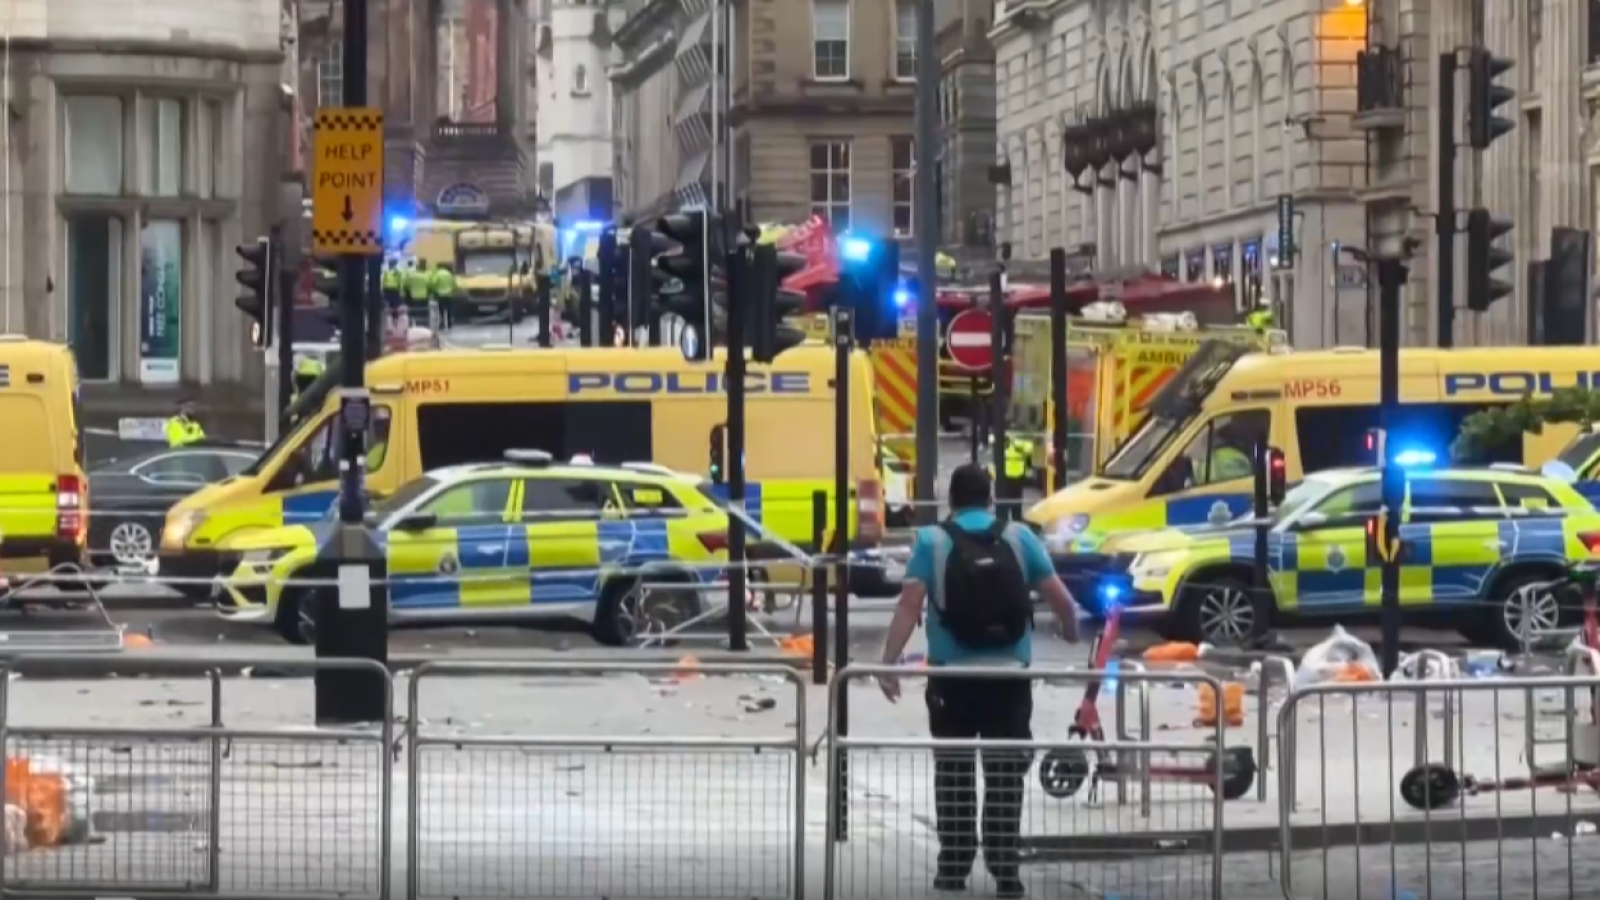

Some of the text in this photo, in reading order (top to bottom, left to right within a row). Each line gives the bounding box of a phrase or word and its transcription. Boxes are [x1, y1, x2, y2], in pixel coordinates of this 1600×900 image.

[324, 143, 372, 161] HELP
[319, 172, 376, 189] POINT
[405, 379, 450, 394] MP51
[568, 371, 810, 394] POLICE
[1283, 379, 1342, 398] MP56
